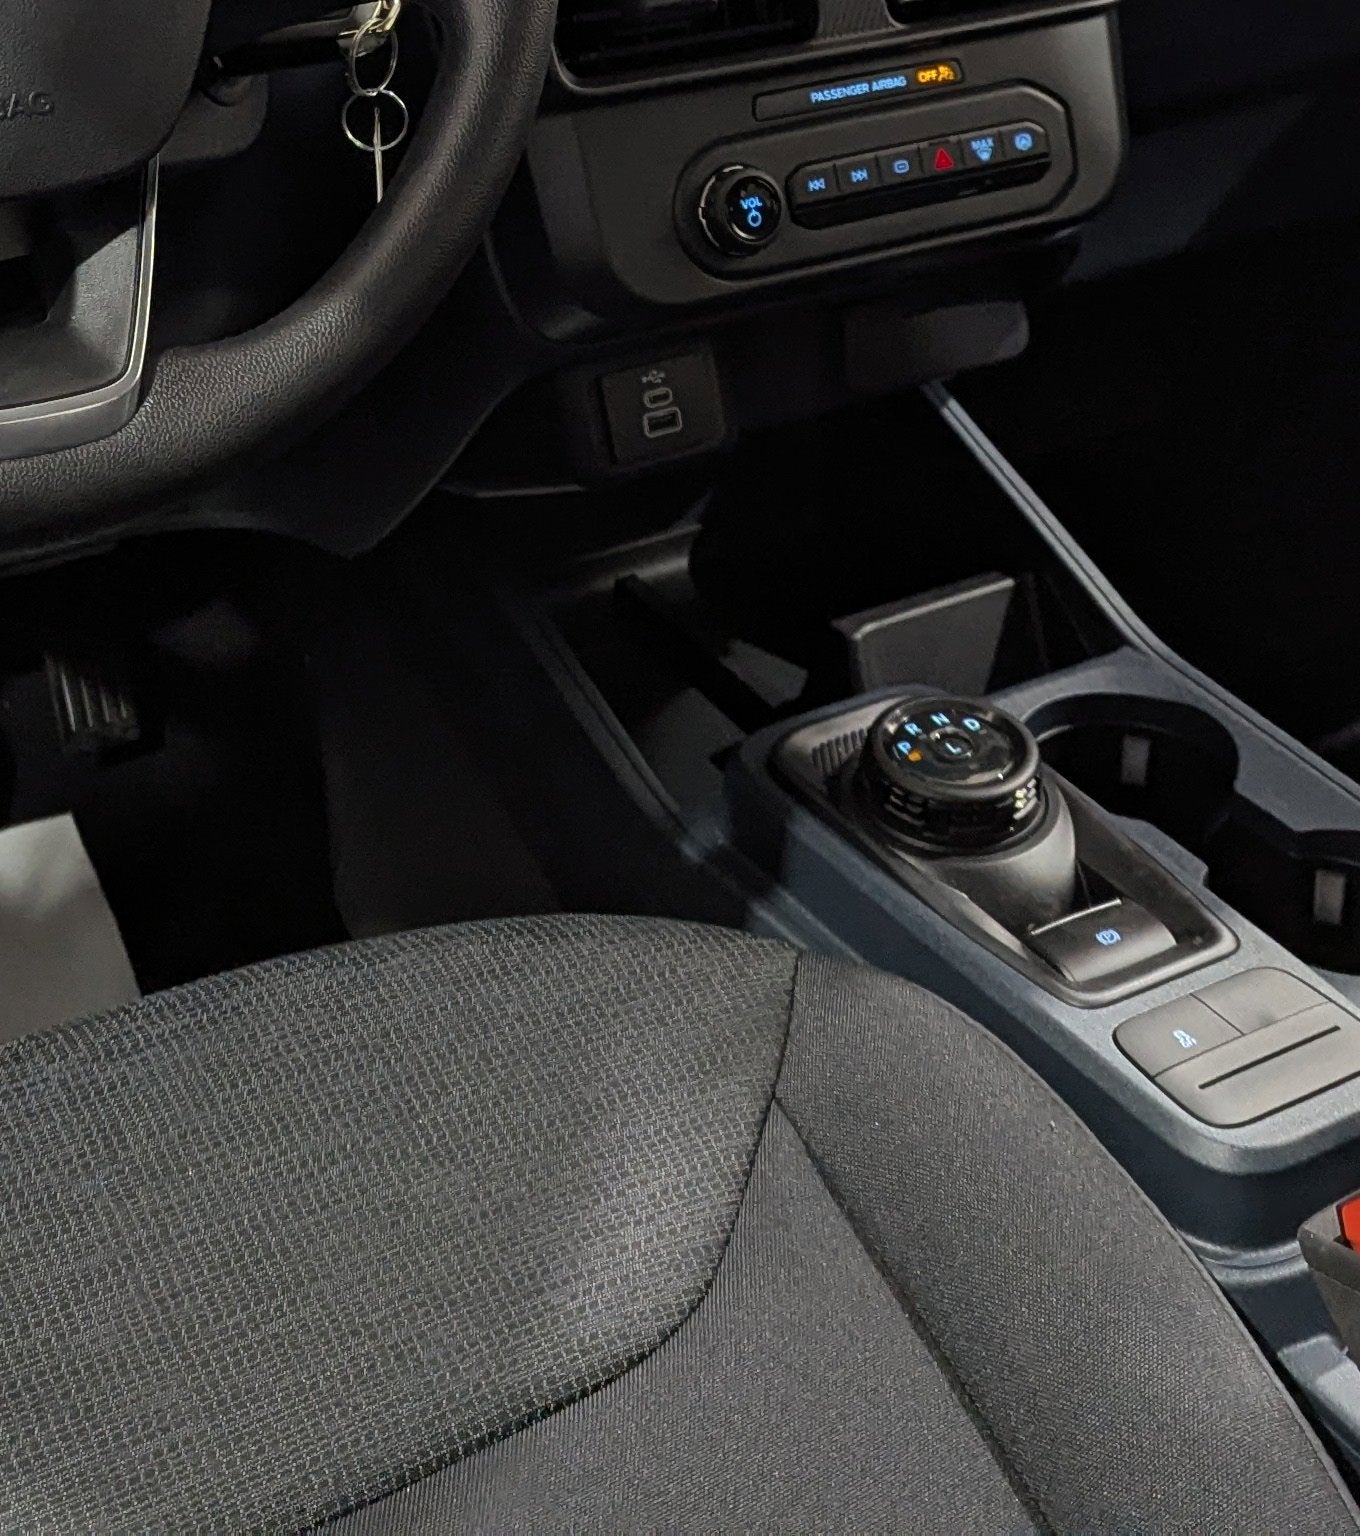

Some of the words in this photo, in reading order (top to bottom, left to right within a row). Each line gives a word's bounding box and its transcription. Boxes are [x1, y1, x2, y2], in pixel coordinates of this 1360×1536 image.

[810, 83, 870, 104] PASSENGER
[871, 75, 908, 93] AIRBAG
[917, 69, 938, 84] OFF
[970, 137, 994, 151] MAX
[740, 195, 763, 209] VOL
[930, 712, 951, 727] N
[962, 717, 981, 732] D
[904, 722, 923, 736] R
[896, 740, 912, 755] P
[944, 741, 963, 755] L
